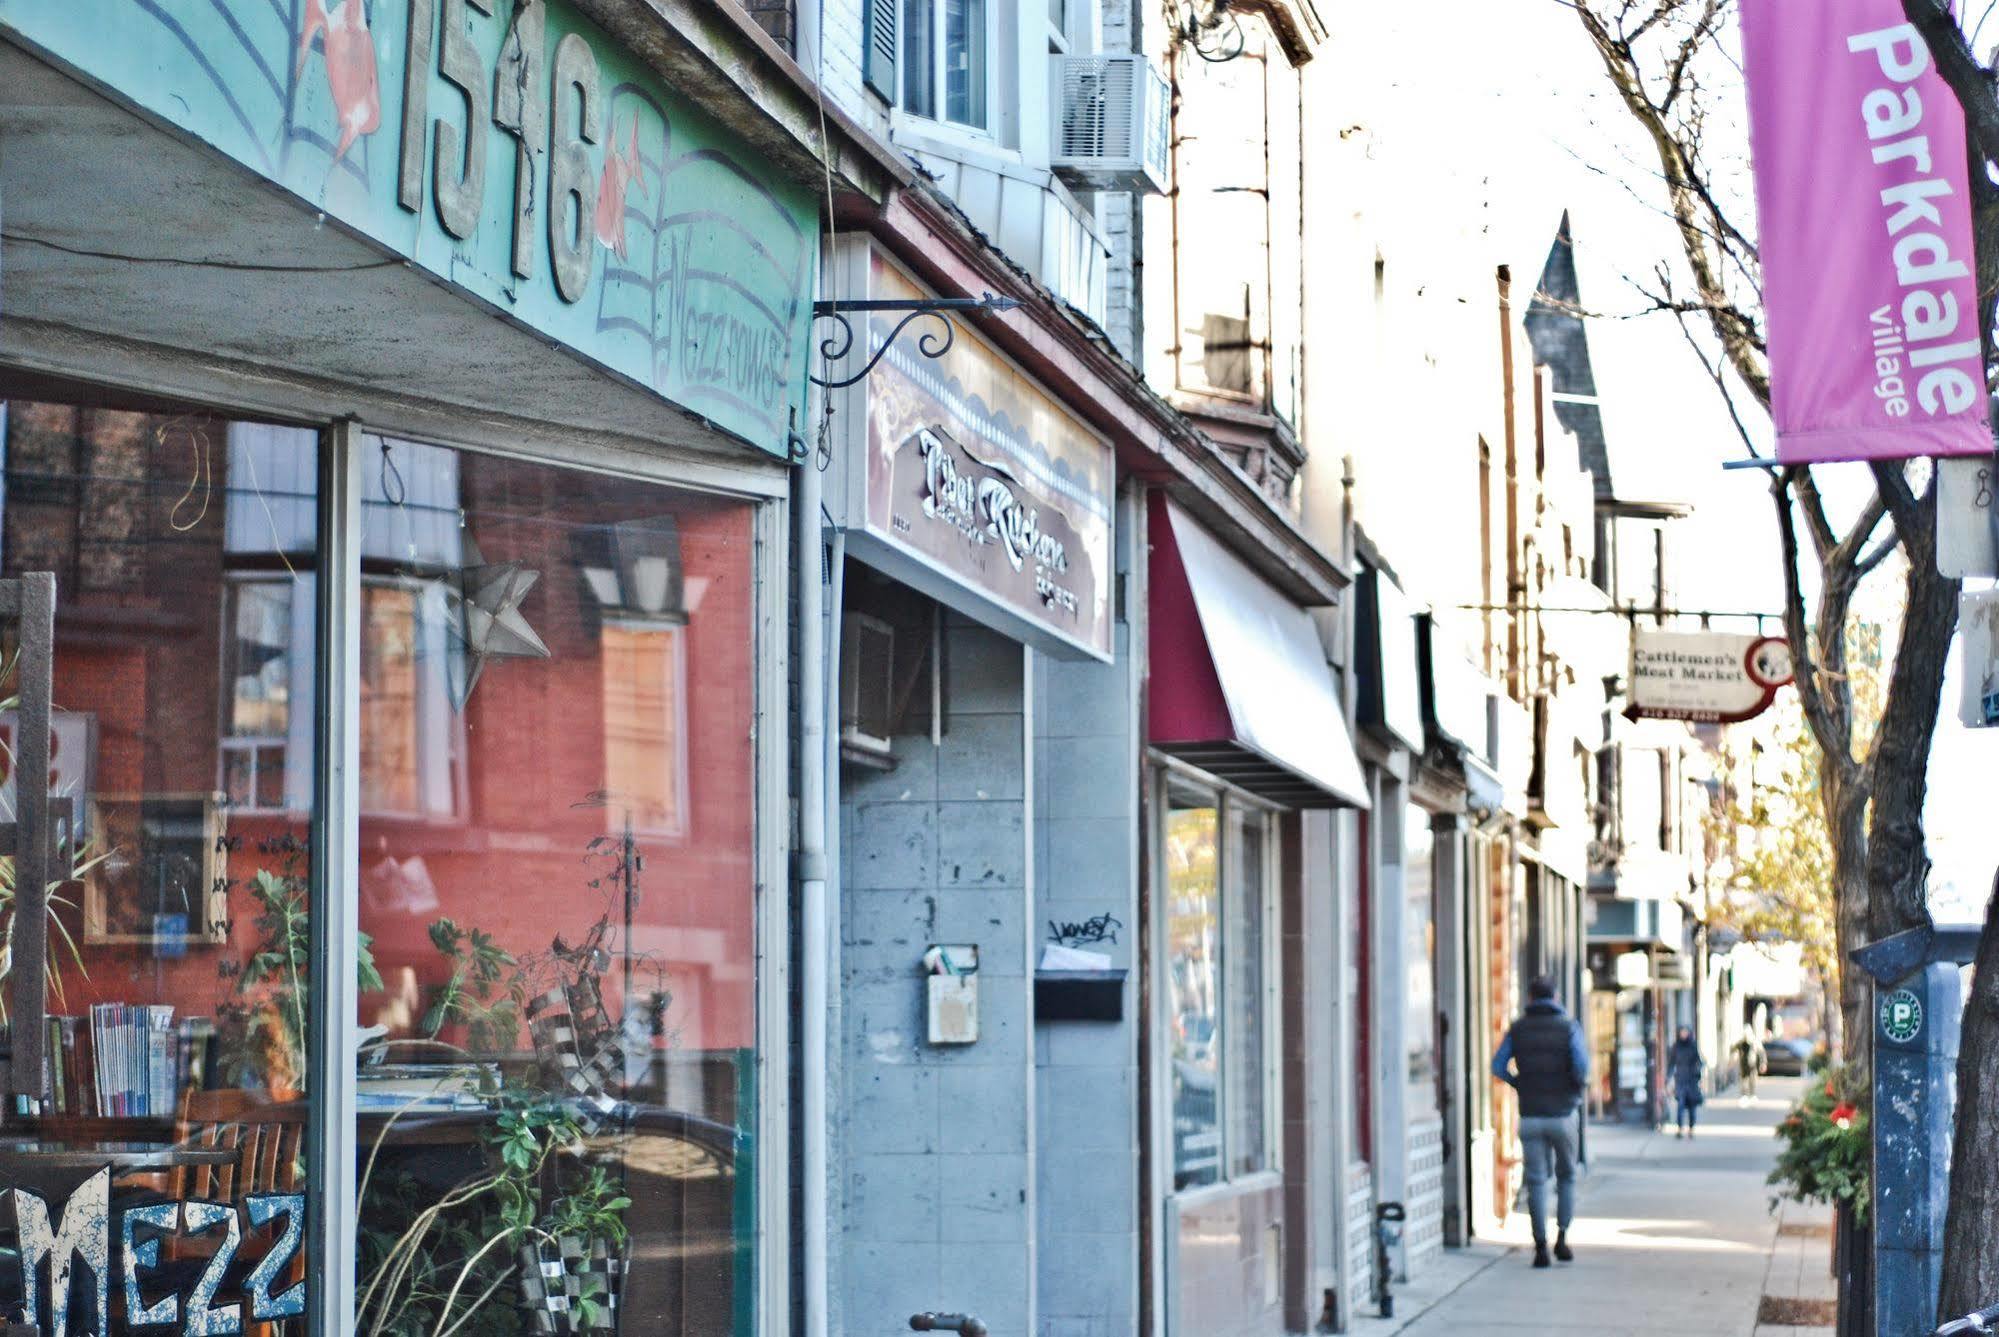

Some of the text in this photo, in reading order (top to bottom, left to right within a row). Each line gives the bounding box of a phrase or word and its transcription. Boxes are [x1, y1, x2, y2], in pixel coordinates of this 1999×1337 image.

[1847, 24, 1980, 416] Parkdale
[1634, 650, 1737, 665] Cattlemen's
[1634, 665, 1743, 681] Meat Market
[1894, 1003, 1911, 1023] P
